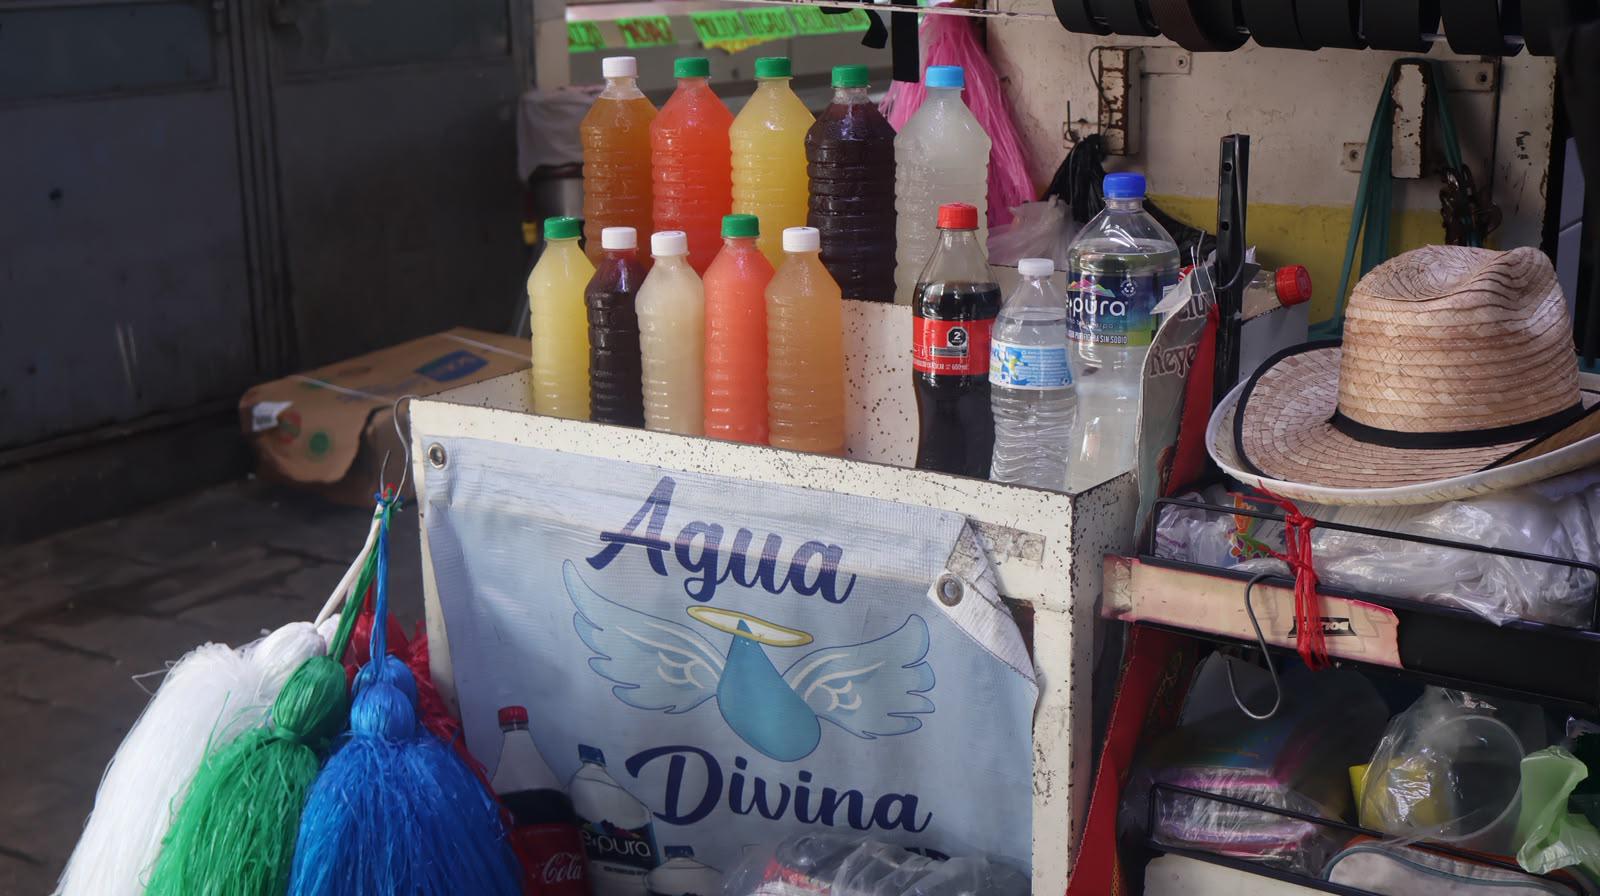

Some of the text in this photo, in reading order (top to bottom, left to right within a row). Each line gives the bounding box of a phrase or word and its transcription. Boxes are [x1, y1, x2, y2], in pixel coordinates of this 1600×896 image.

[953, 331, 961, 340] 2
[586, 476, 856, 604] Agua
[625, 745, 933, 833] Divina
[542, 852, 584, 885] Cola
